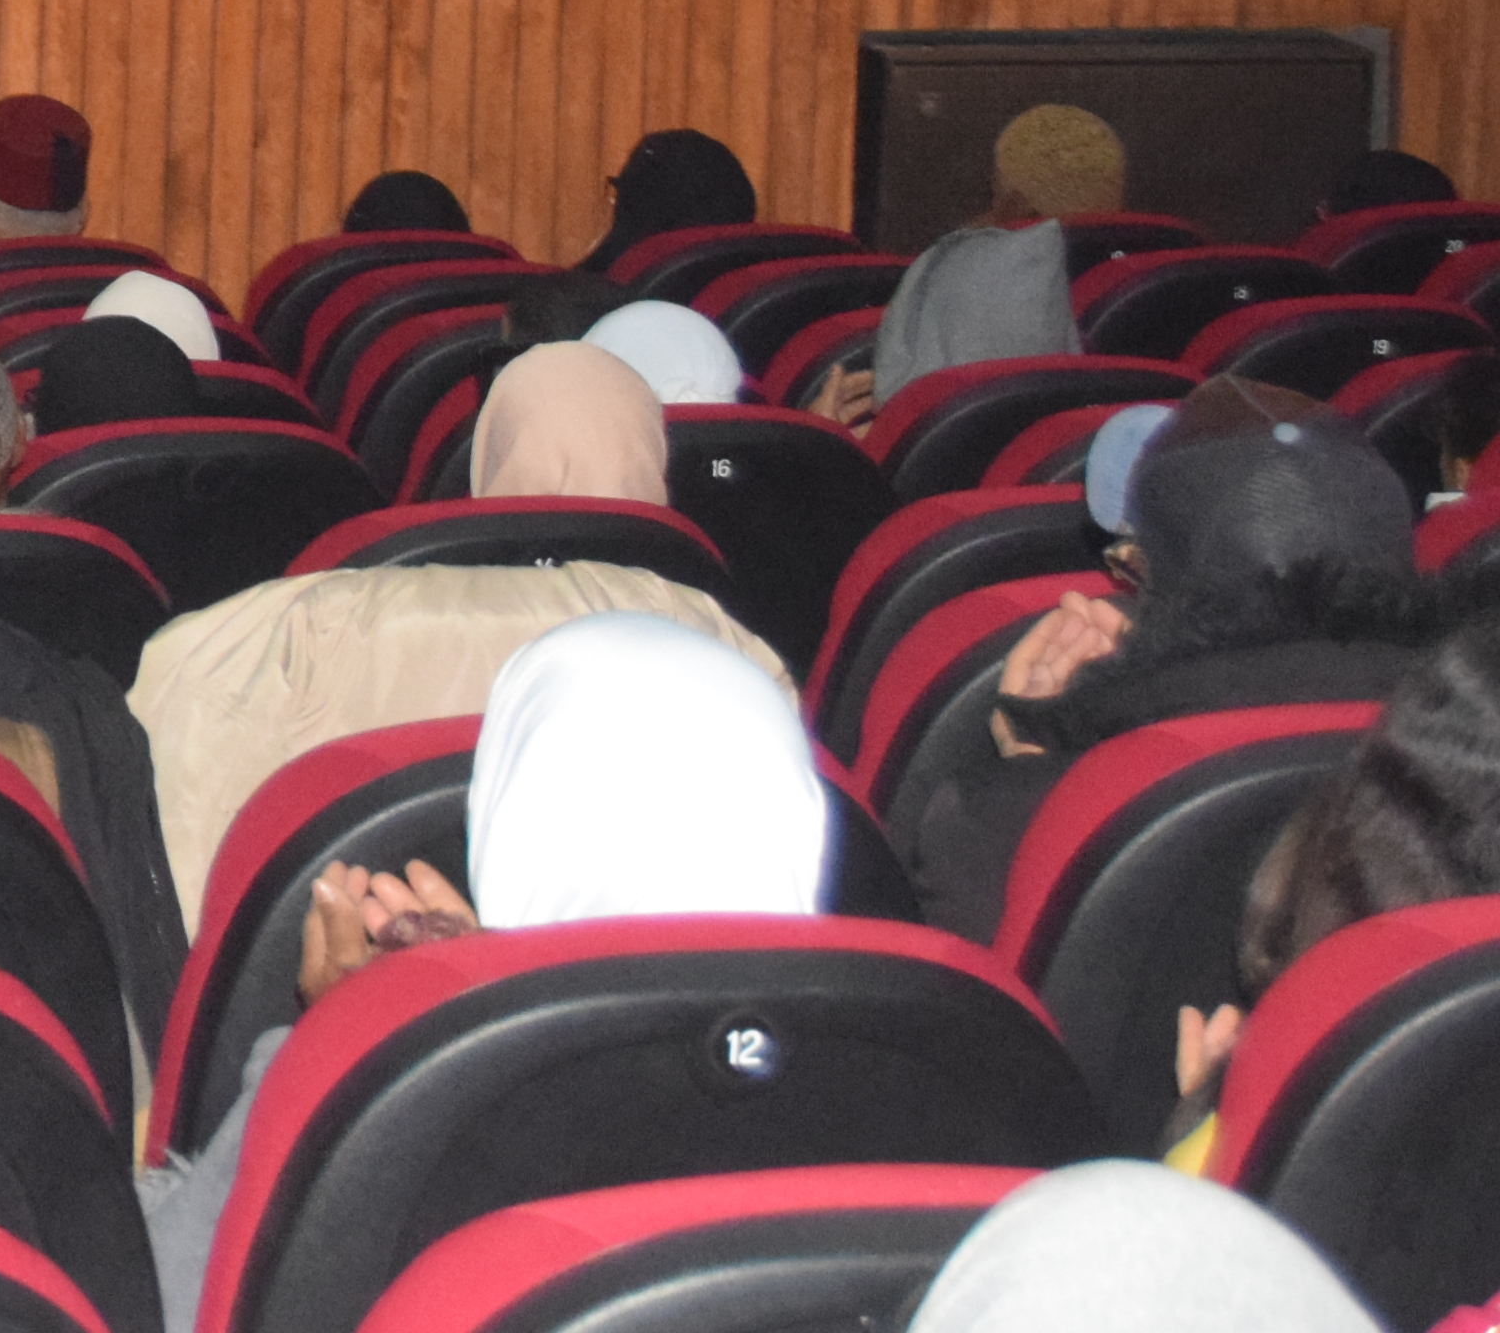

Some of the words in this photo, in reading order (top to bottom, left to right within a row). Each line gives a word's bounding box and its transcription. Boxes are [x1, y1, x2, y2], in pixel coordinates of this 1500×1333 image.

[1373, 338, 1391, 355] 19
[711, 458, 732, 479] 16
[725, 1028, 765, 1068] 12
